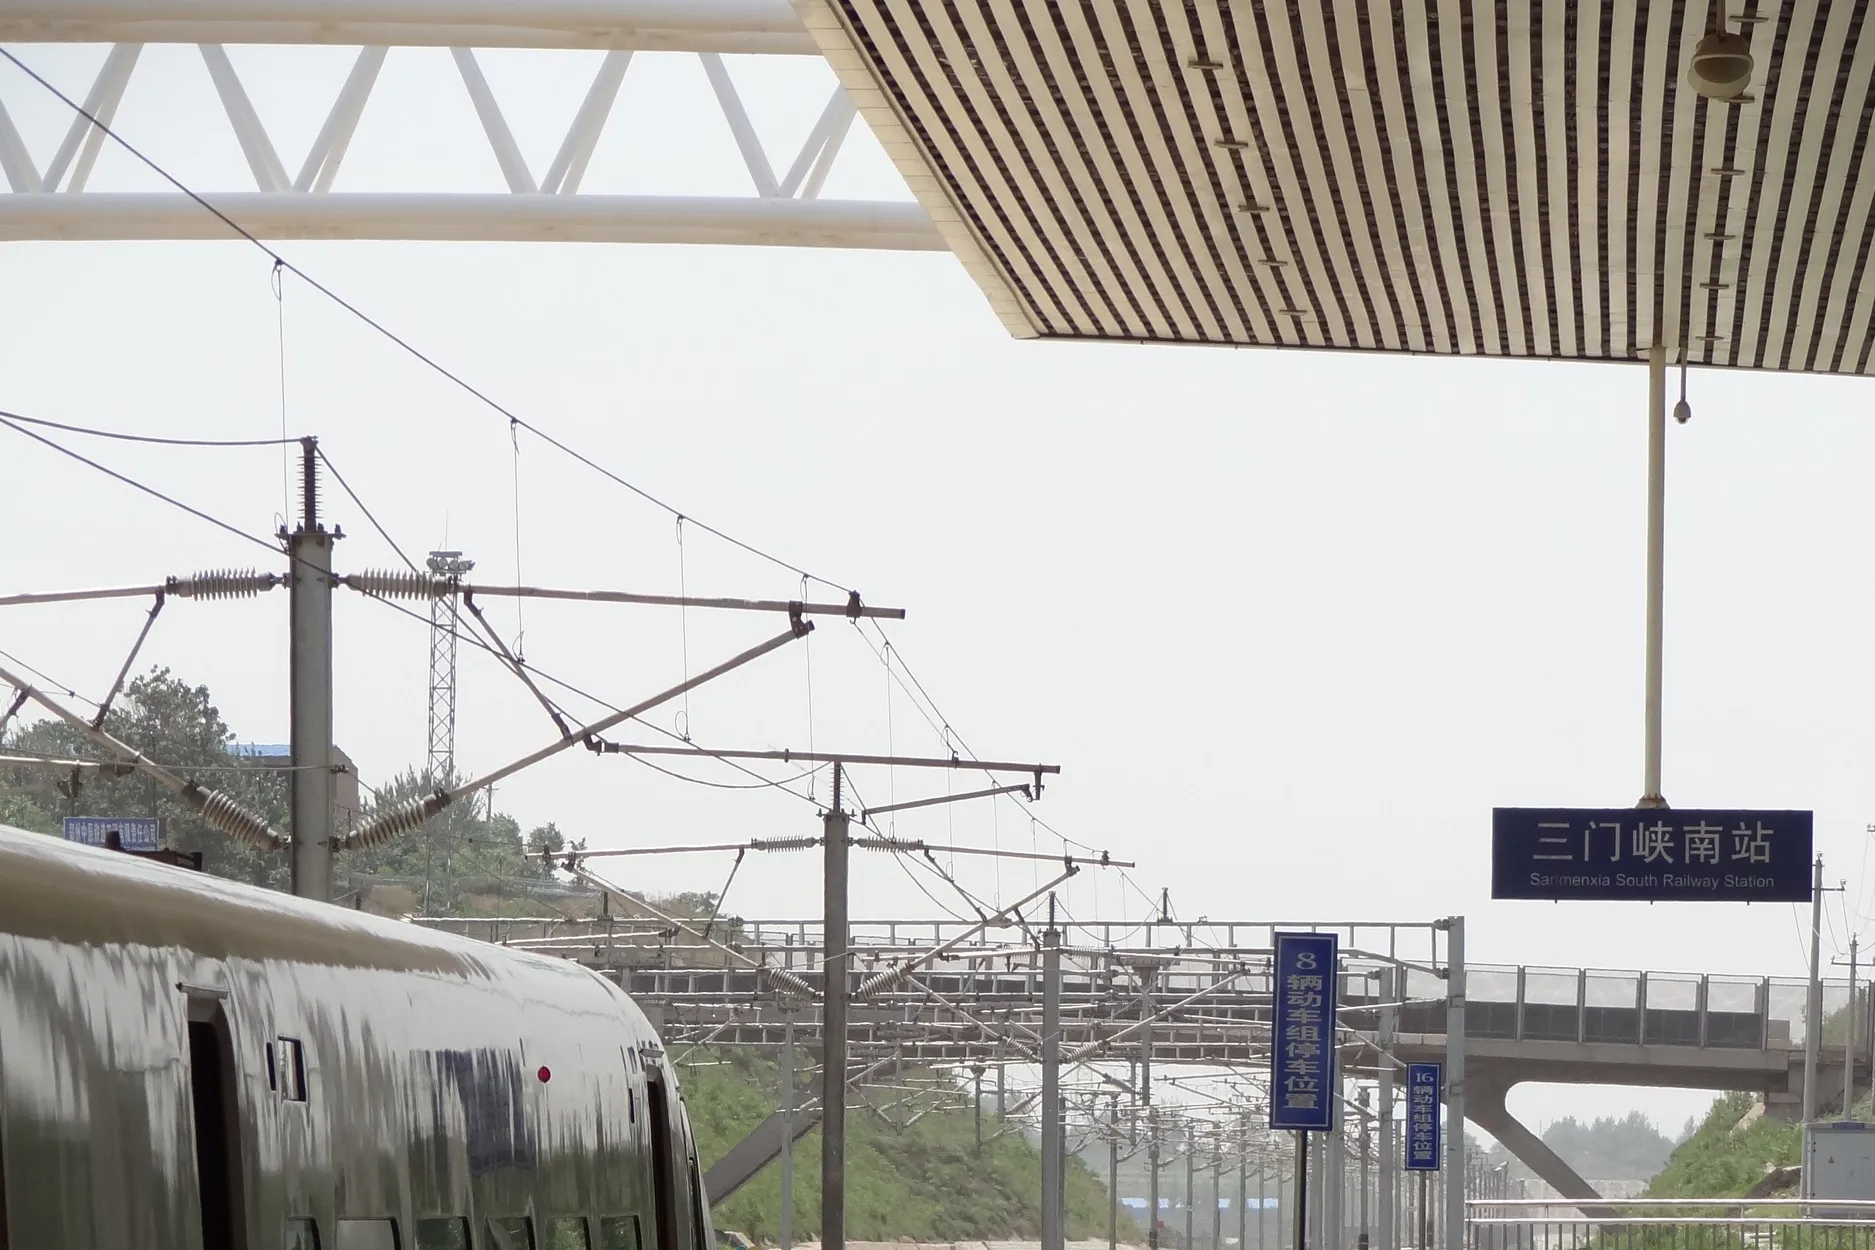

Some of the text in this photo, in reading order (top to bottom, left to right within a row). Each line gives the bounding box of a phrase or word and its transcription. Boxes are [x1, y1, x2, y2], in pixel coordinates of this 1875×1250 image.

[1533, 820, 1774, 865] 三门峡南站
[1529, 872, 1775, 890] Sanmenxia South Railway Station
